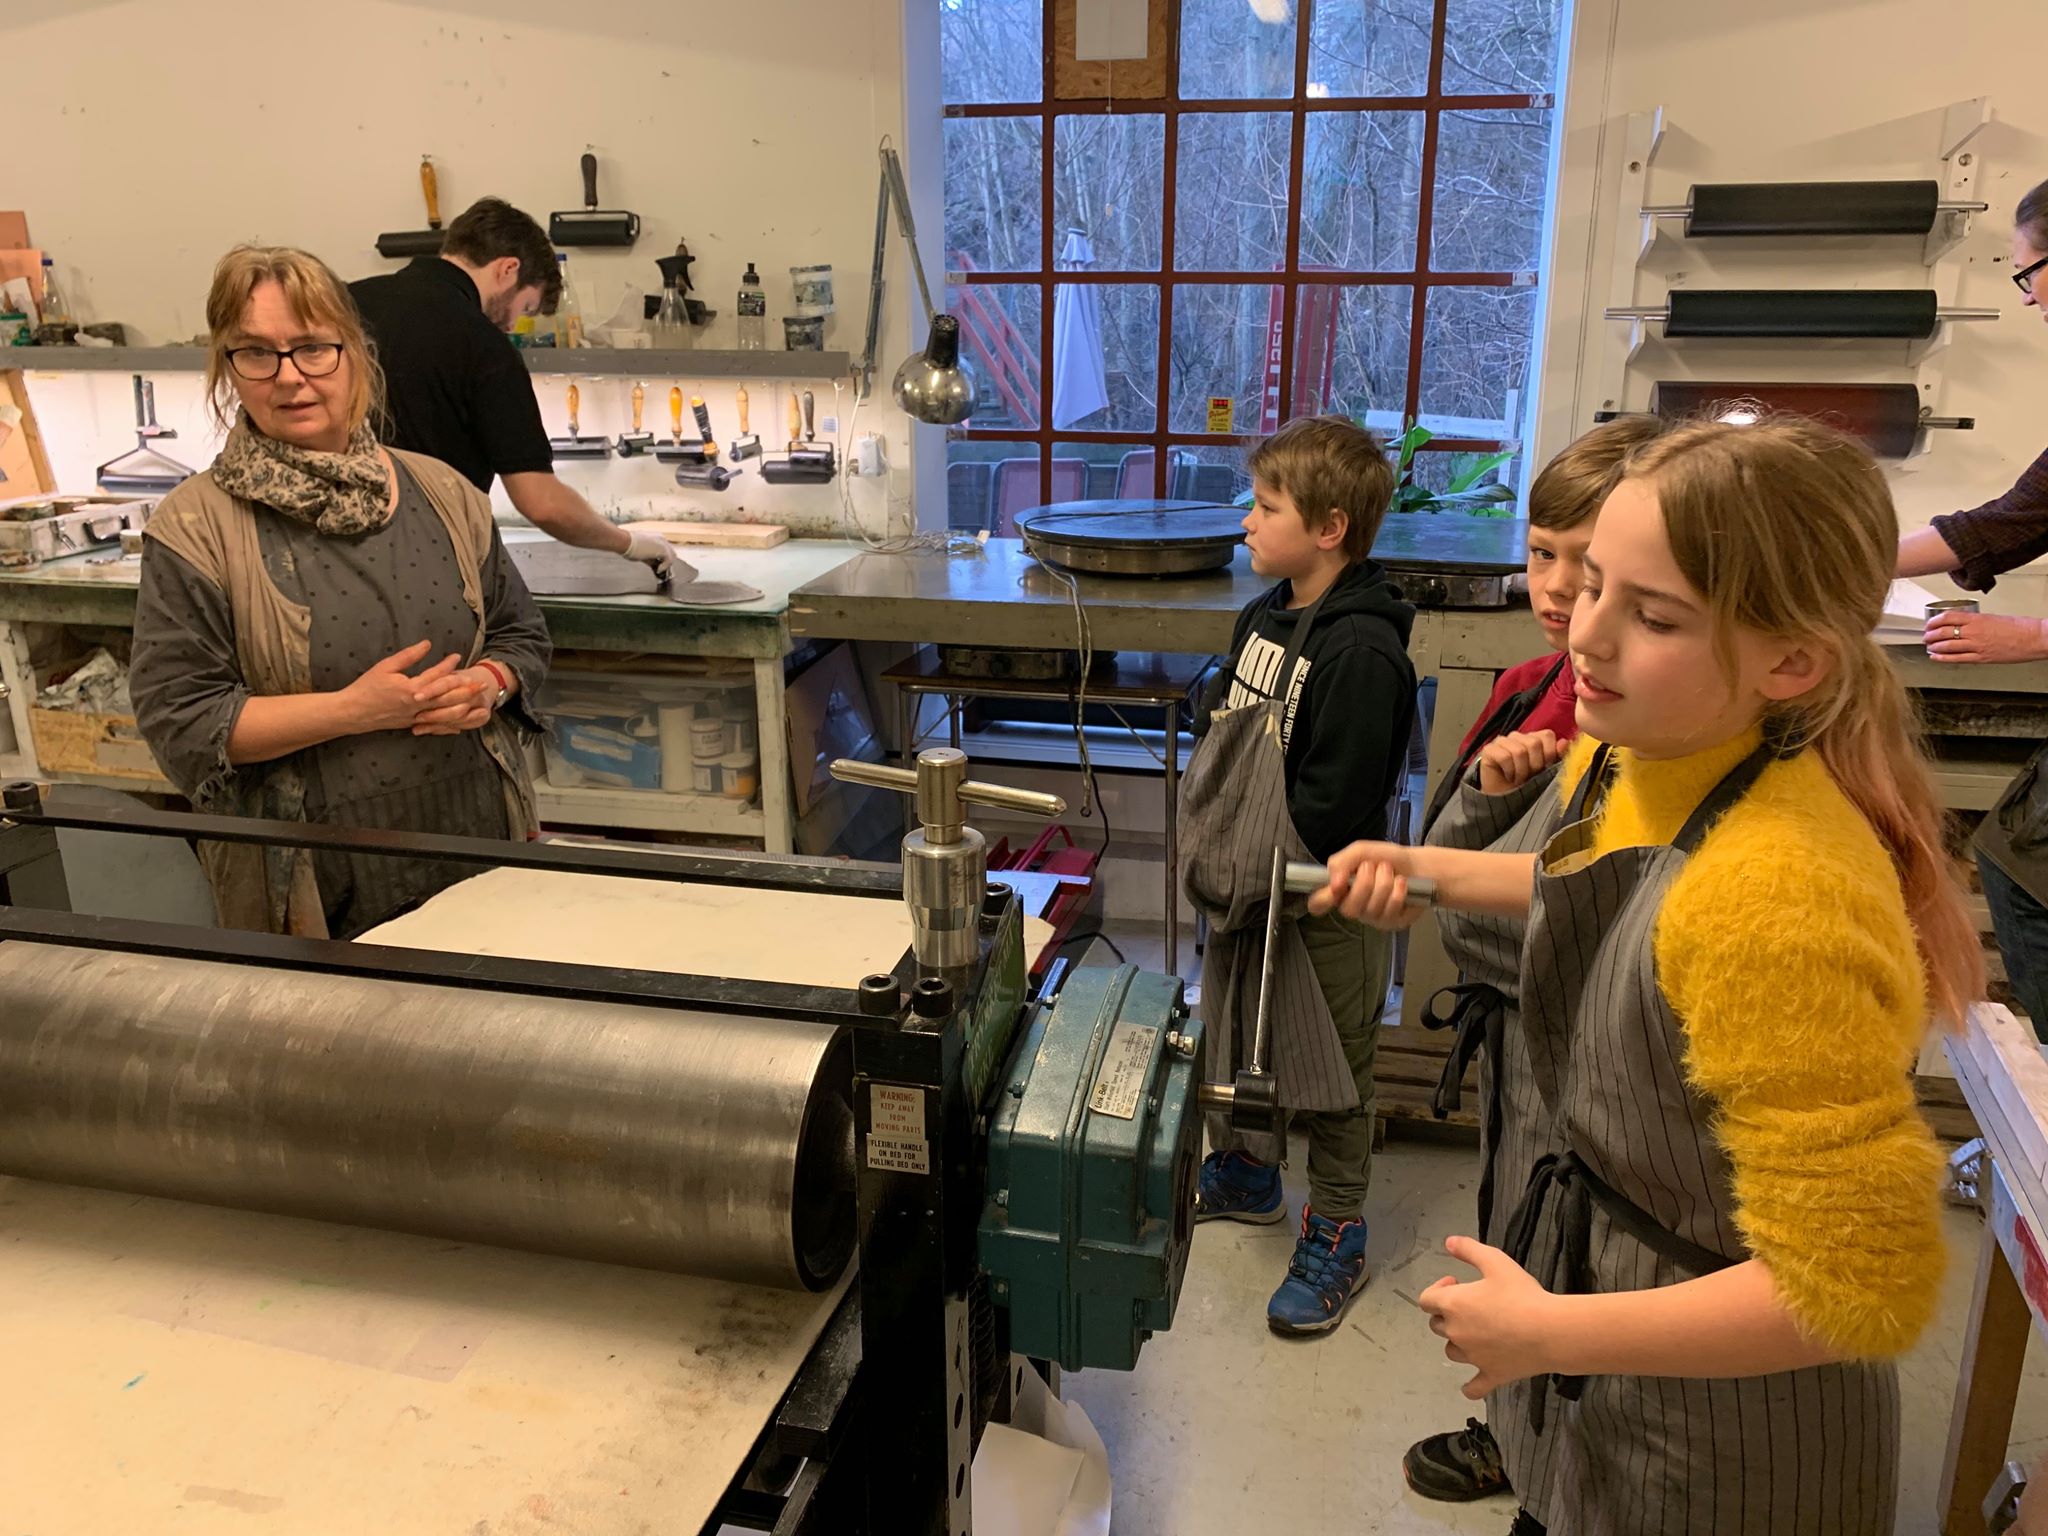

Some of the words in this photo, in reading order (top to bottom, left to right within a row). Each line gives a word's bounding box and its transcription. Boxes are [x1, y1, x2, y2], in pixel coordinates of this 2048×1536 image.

[1297, 660, 1312, 683] SINCE
[1286, 682, 1303, 719] NINETEEN
[1282, 718, 1294, 744] FORTY
[881, 1103, 895, 1111] KEEP
[898, 1105, 915, 1113] AWAY
[889, 1113, 906, 1121] FROM
[876, 1122, 900, 1132] MOVING
[902, 1125, 921, 1135] PARTS
[871, 1139, 897, 1150] FLEXIBLE
[900, 1143, 923, 1152] HANDLE
[878, 1149, 887, 1157] ON
[889, 1150, 902, 1159] BED
[904, 1152, 916, 1161] FOR
[870, 1157, 895, 1167] PULLING
[897, 1160, 909, 1169] BED
[911, 1163, 926, 1171] ONLY
